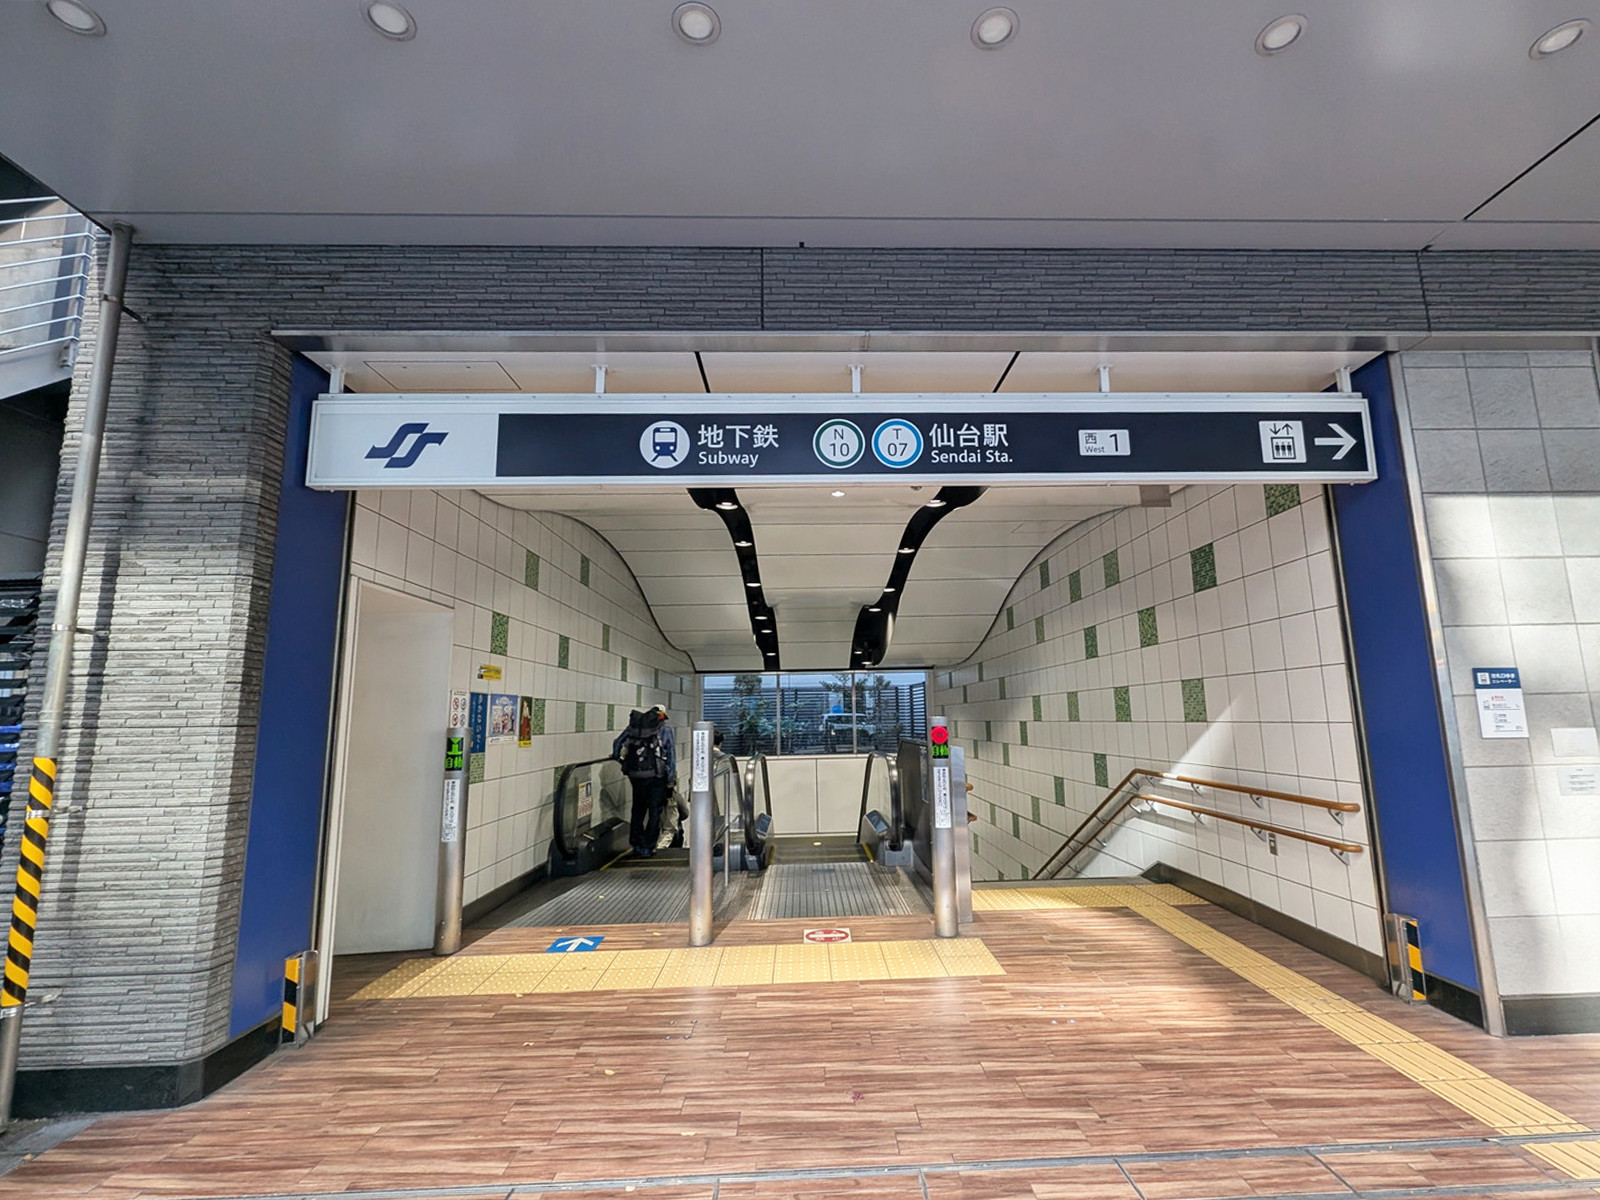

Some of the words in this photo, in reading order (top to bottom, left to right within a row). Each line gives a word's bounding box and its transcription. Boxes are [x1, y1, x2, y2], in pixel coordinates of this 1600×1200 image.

[697, 424, 779, 448] 地下鉄
[833, 428, 844, 440] N
[892, 428, 902, 440] T
[929, 423, 1009, 447] 仙台駅
[1084, 432, 1097, 445] 西
[829, 442, 850, 457] 10
[887, 442, 908, 457] 07
[1109, 432, 1119, 452] 1
[698, 451, 759, 468] Subway
[931, 449, 981, 463] Sendai
[985, 450, 1013, 463] Sta.
